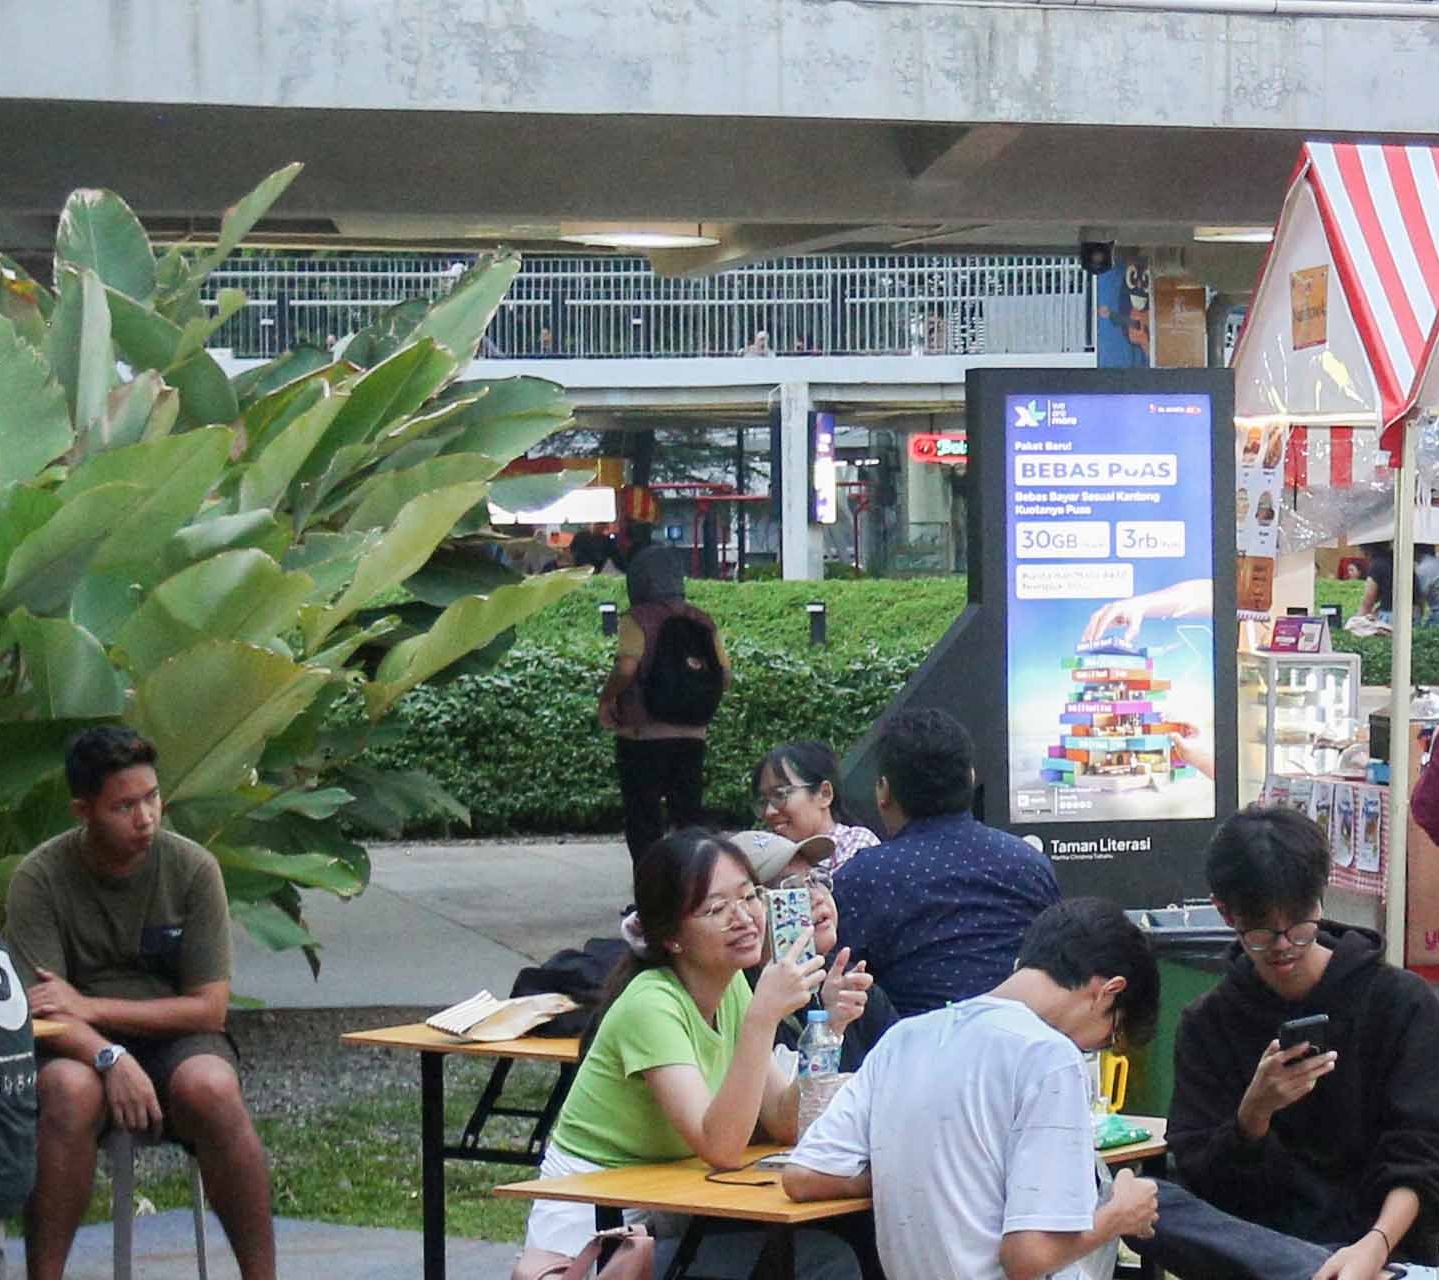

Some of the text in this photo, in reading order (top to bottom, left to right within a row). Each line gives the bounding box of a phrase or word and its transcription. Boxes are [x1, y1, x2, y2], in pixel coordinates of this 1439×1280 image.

[1014, 441, 1072, 451] Paket Baru!
[1021, 462, 1100, 479] BEBAS
[1015, 492, 1047, 502] Bebas
[1049, 492, 1080, 504] Bayar
[1116, 492, 1161, 504] Kantong
[1022, 529, 1078, 549] 30GB
[1122, 528, 1158, 549] 3rb
[1050, 836, 1151, 854] Taman Literasi
